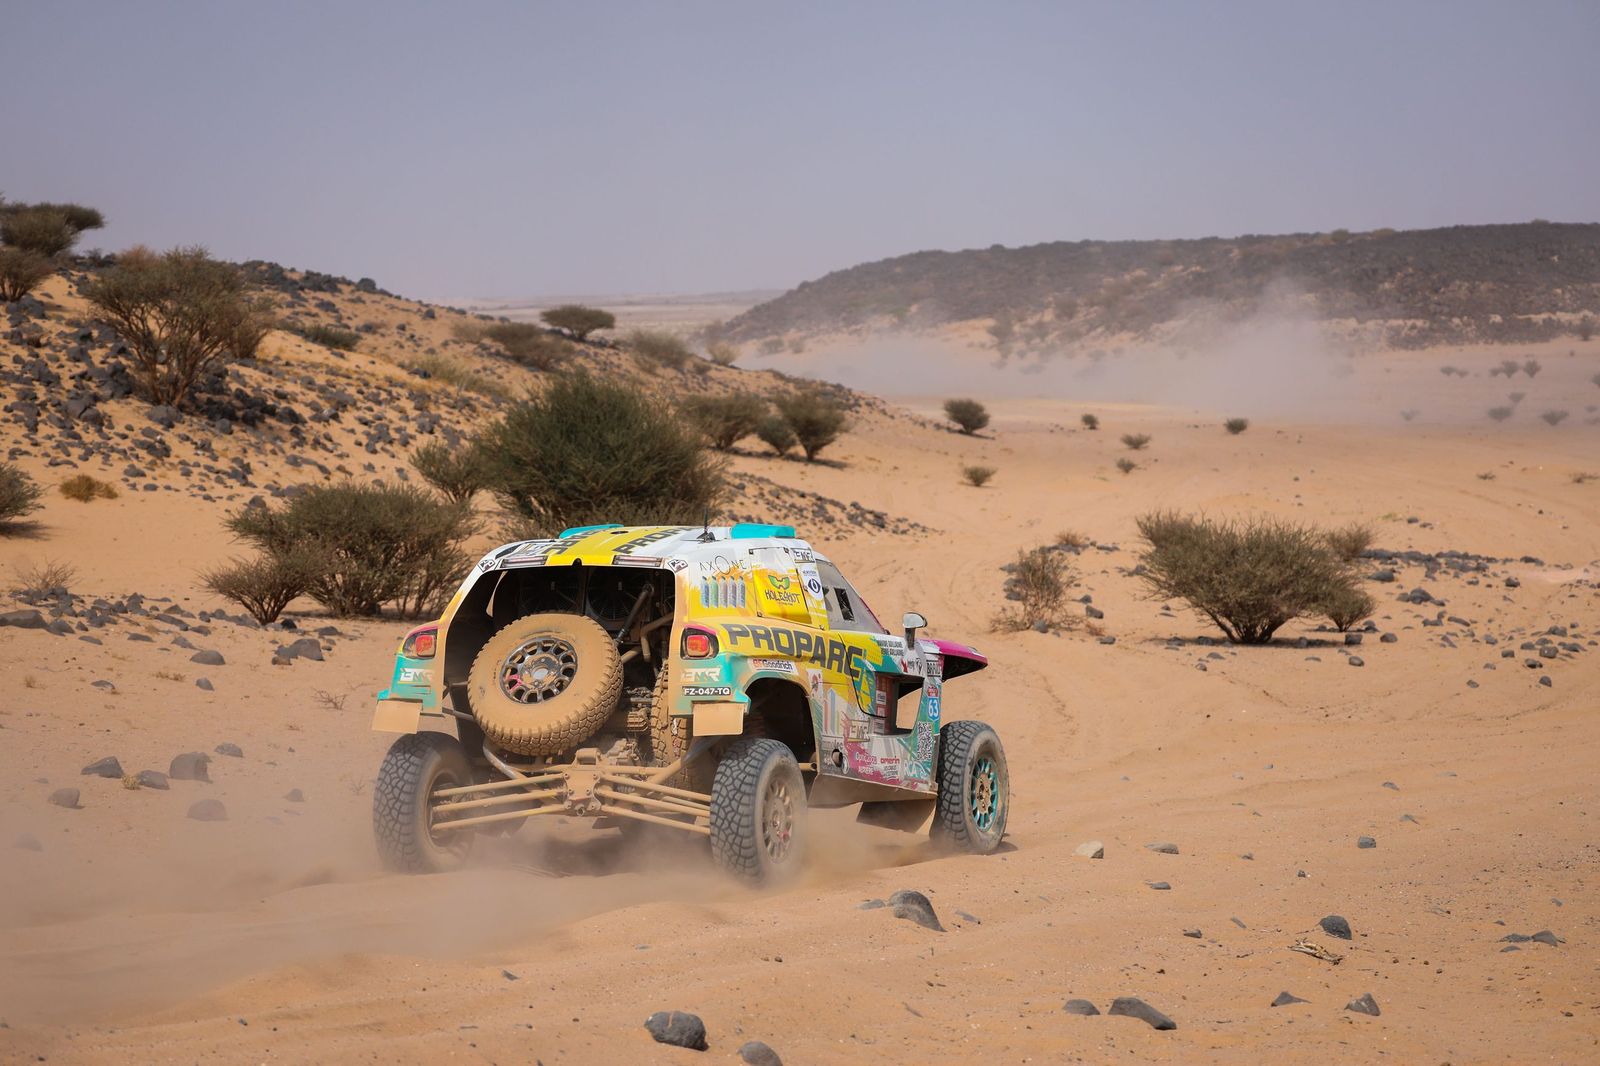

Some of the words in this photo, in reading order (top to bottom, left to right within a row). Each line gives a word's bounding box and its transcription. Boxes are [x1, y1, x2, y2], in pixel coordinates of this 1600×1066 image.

[764, 588, 802, 604] HOLESHOT
[720, 624, 863, 678] PROPARC
[753, 659, 793, 670] BFGoodrich
[684, 688, 730, 696] FZ-047-TQ
[928, 699, 939, 718] 63
